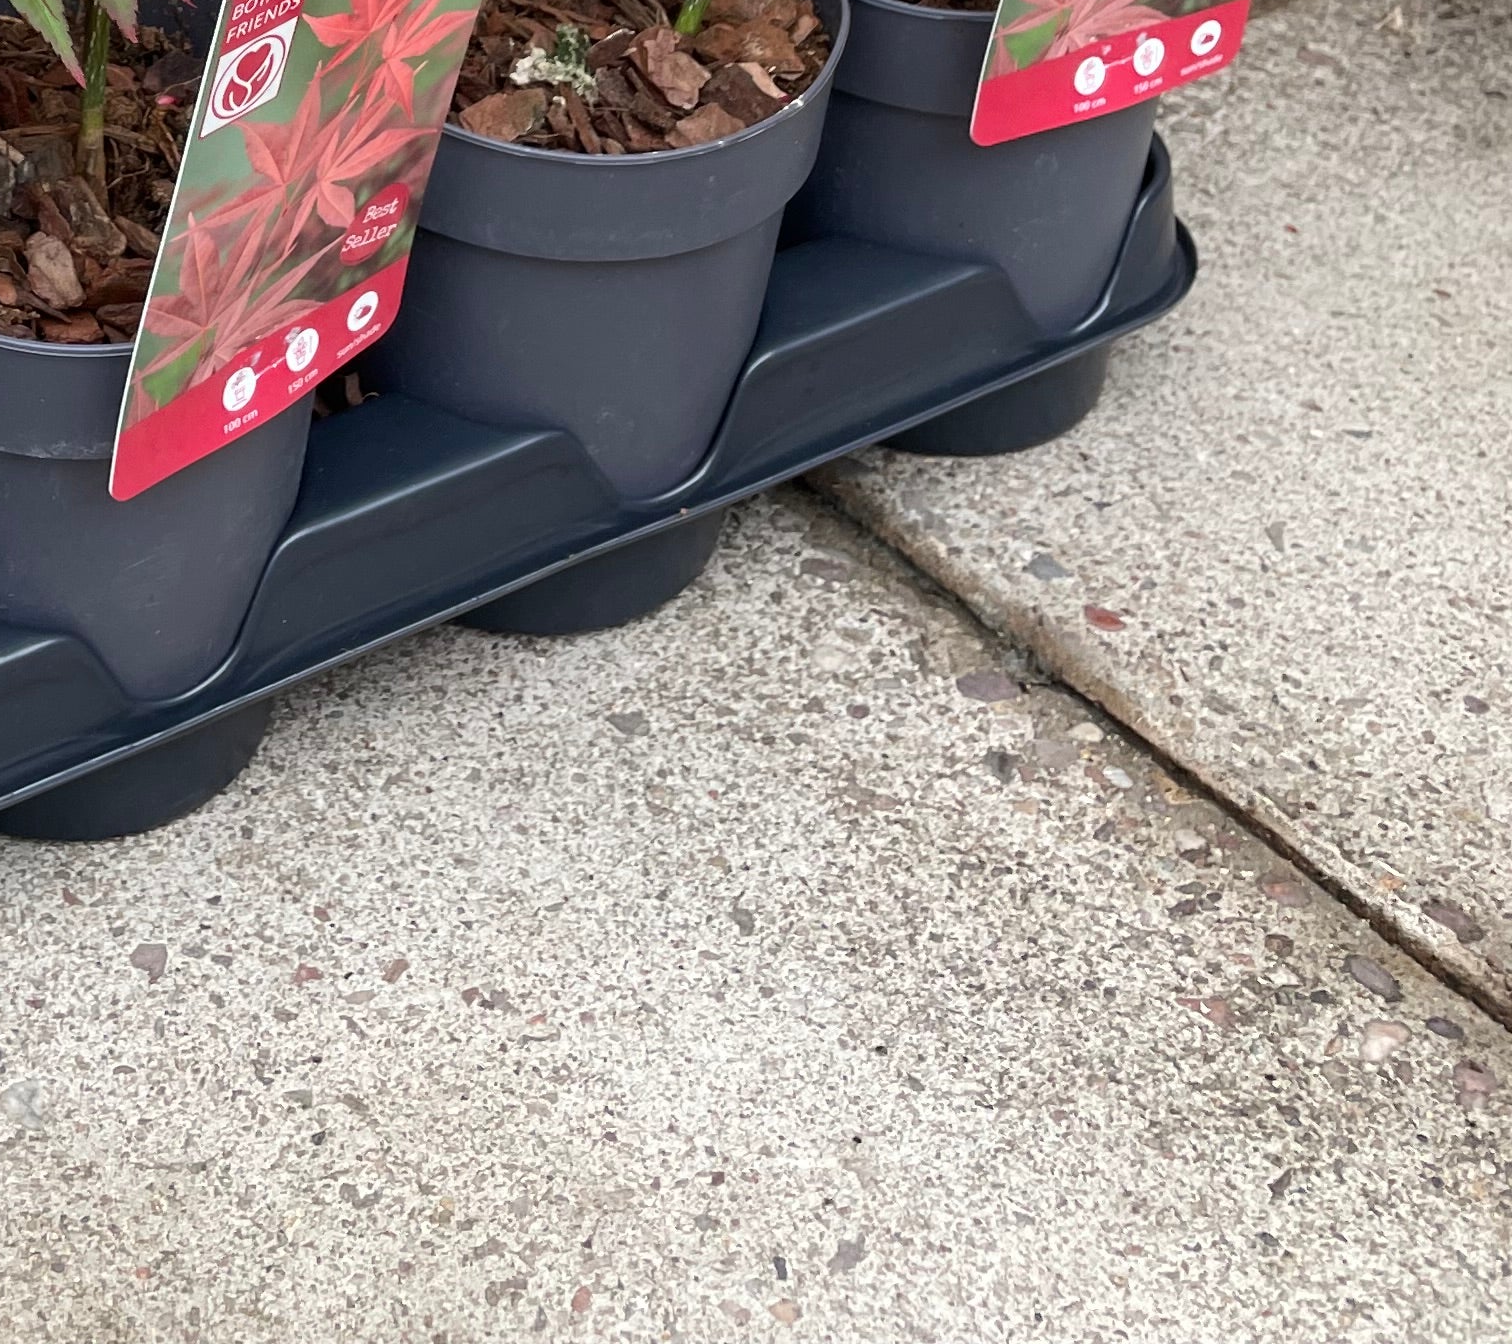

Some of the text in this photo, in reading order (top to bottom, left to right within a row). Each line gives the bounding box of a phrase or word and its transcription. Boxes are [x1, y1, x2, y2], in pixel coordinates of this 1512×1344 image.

[362, 197, 400, 224] Best
[341, 222, 398, 252] Seller
[223, 416, 241, 435] 100
